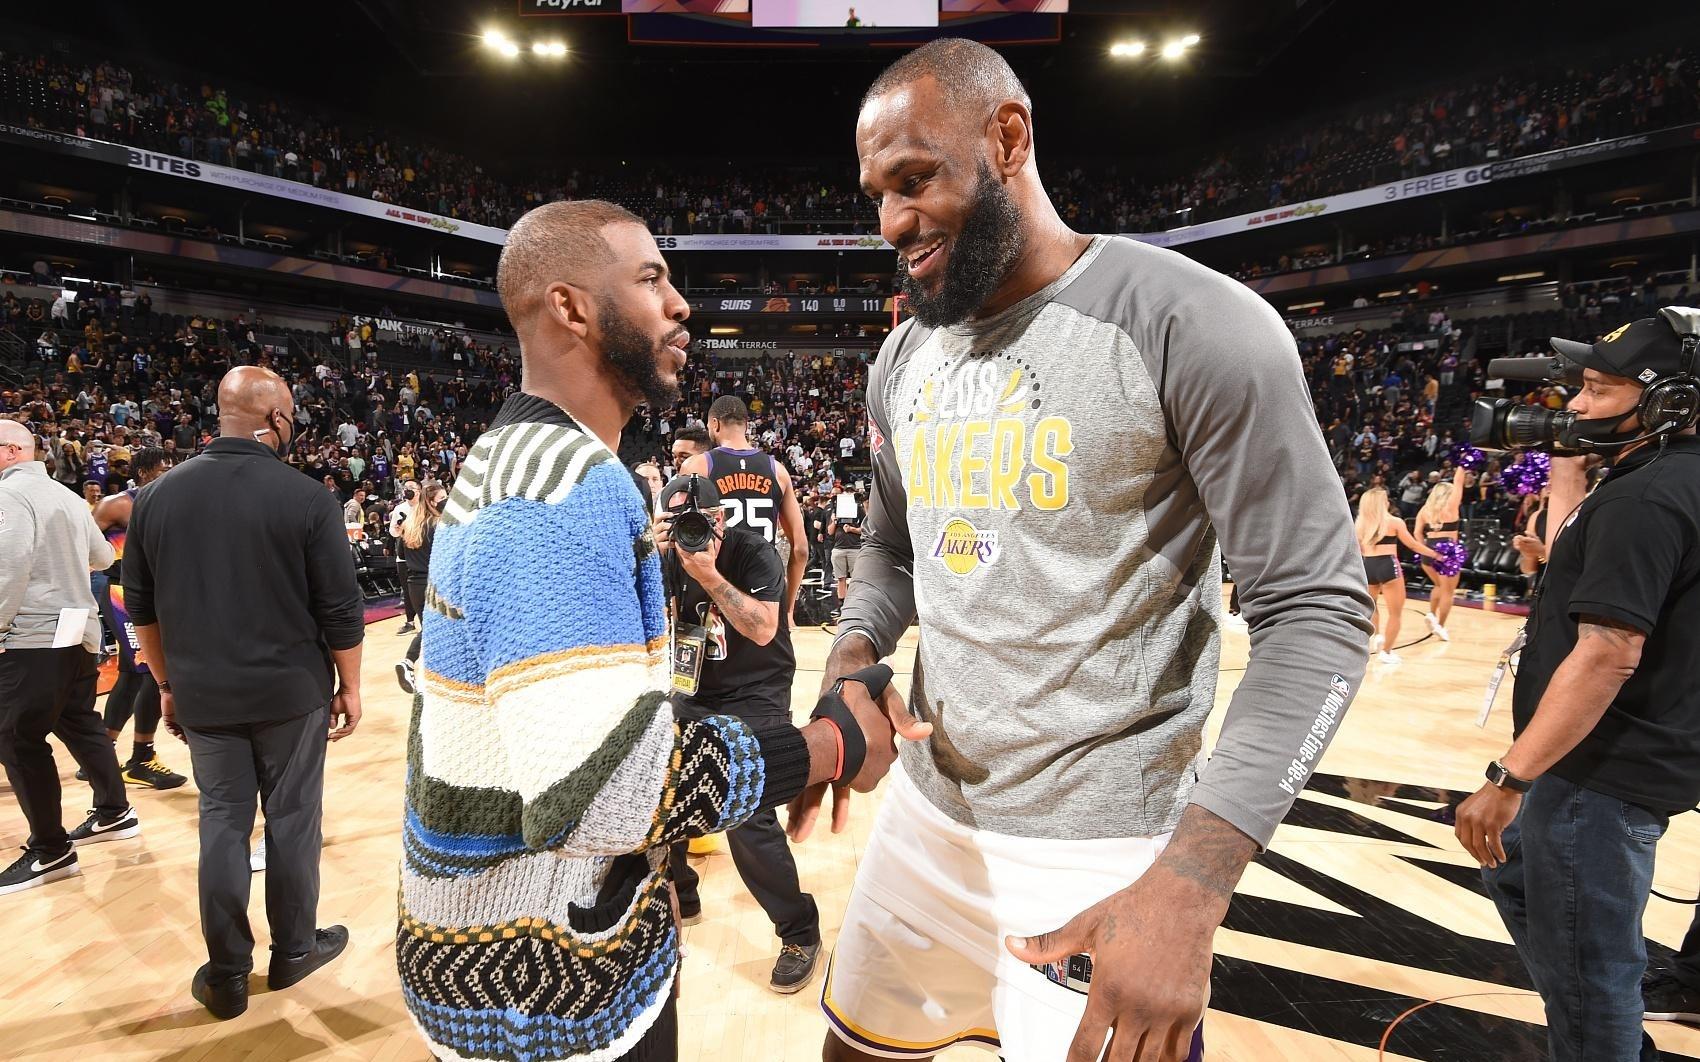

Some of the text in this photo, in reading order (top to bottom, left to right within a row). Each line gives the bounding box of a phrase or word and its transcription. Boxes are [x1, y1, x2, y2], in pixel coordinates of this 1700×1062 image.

[63, 137, 95, 150] GAME
[1616, 136, 1648, 150] GAME
[128, 150, 201, 178] BITES
[1384, 186, 1397, 200] 3
[1402, 173, 1459, 197] FREE
[720, 299, 752, 310] SUNS
[801, 299, 819, 312] 140
[862, 299, 879, 312] 111
[405, 325, 437, 336] TERRA
[741, 341, 777, 349] TERRACE
[939, 361, 998, 418] LOS
[892, 416, 1075, 511] AKERS
[716, 472, 773, 495] BRIDGES
[719, 498, 774, 543] 25
[934, 531, 995, 564] LAKERS
[123, 622, 141, 649] SUNS
[1311, 690, 1344, 739] Noches
